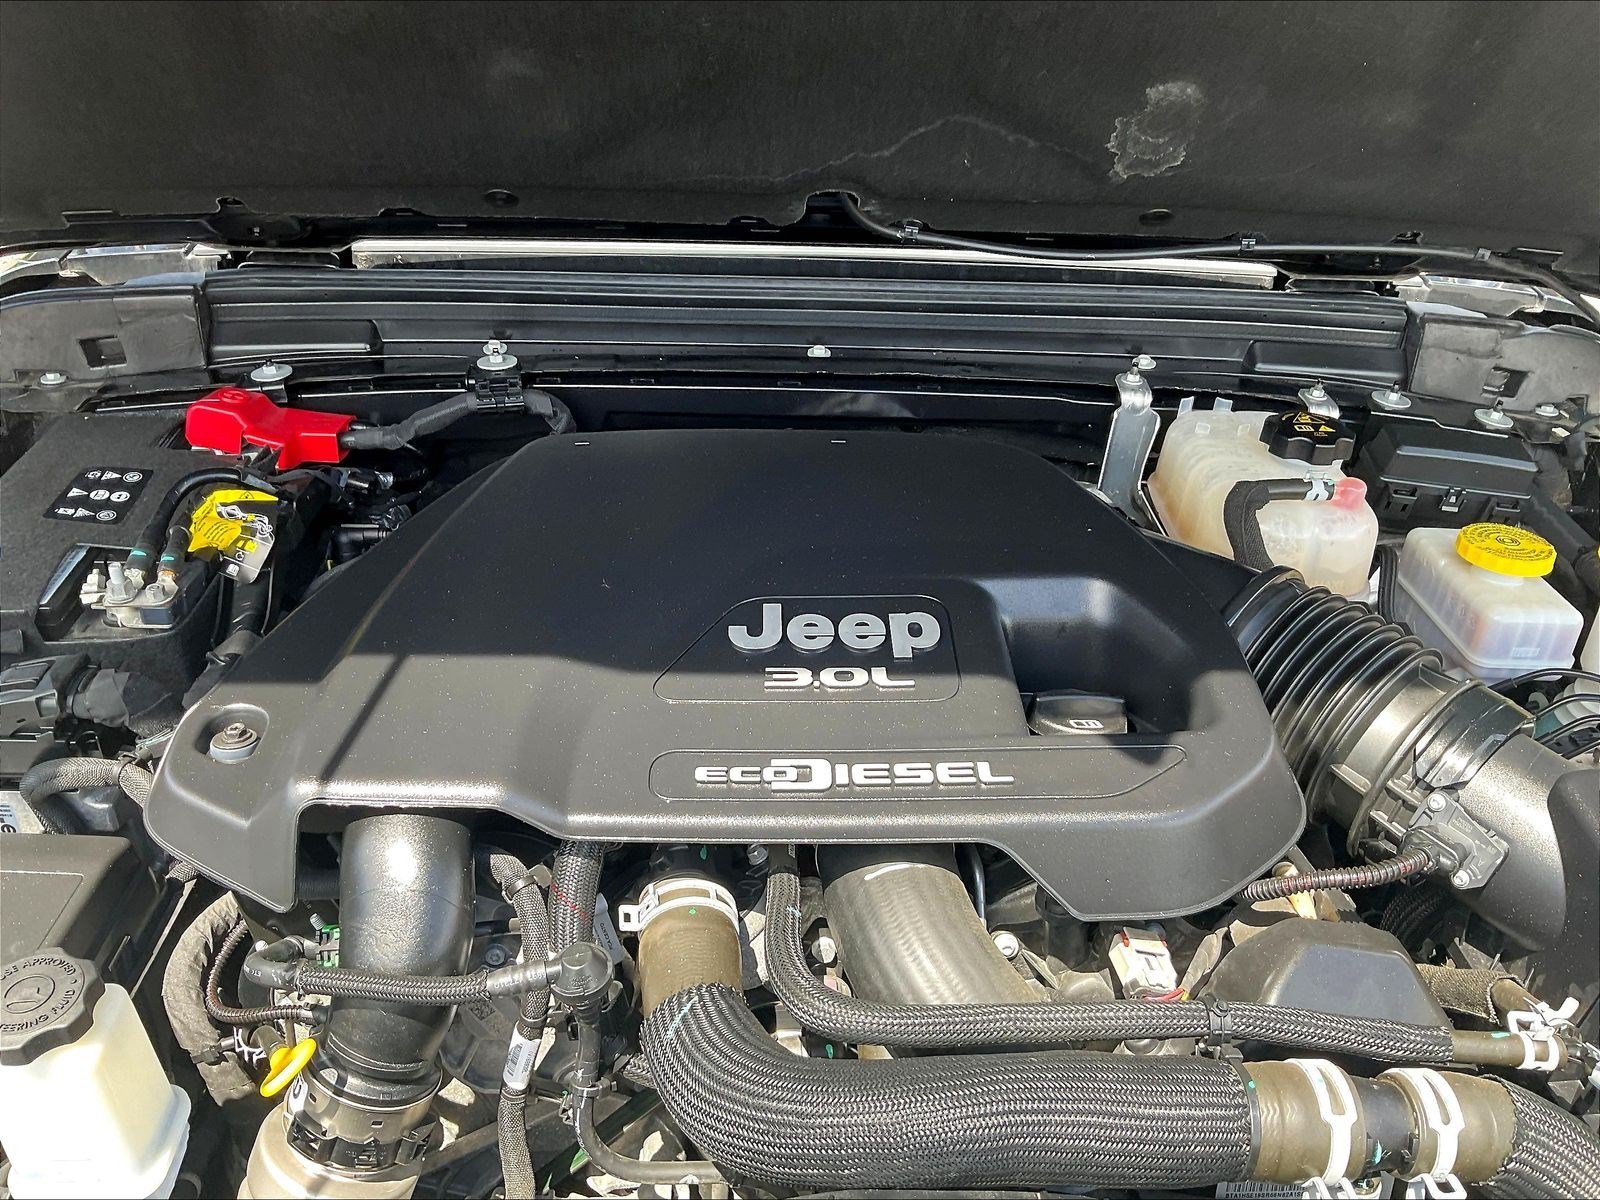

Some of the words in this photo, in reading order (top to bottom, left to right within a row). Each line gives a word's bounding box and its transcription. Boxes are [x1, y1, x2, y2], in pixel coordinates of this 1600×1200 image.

[727, 602, 942, 660] Jeep
[764, 666, 916, 691] 3.0L
[23, 957, 77, 976] APPROVED
[51, 989, 76, 1015] FLUID
